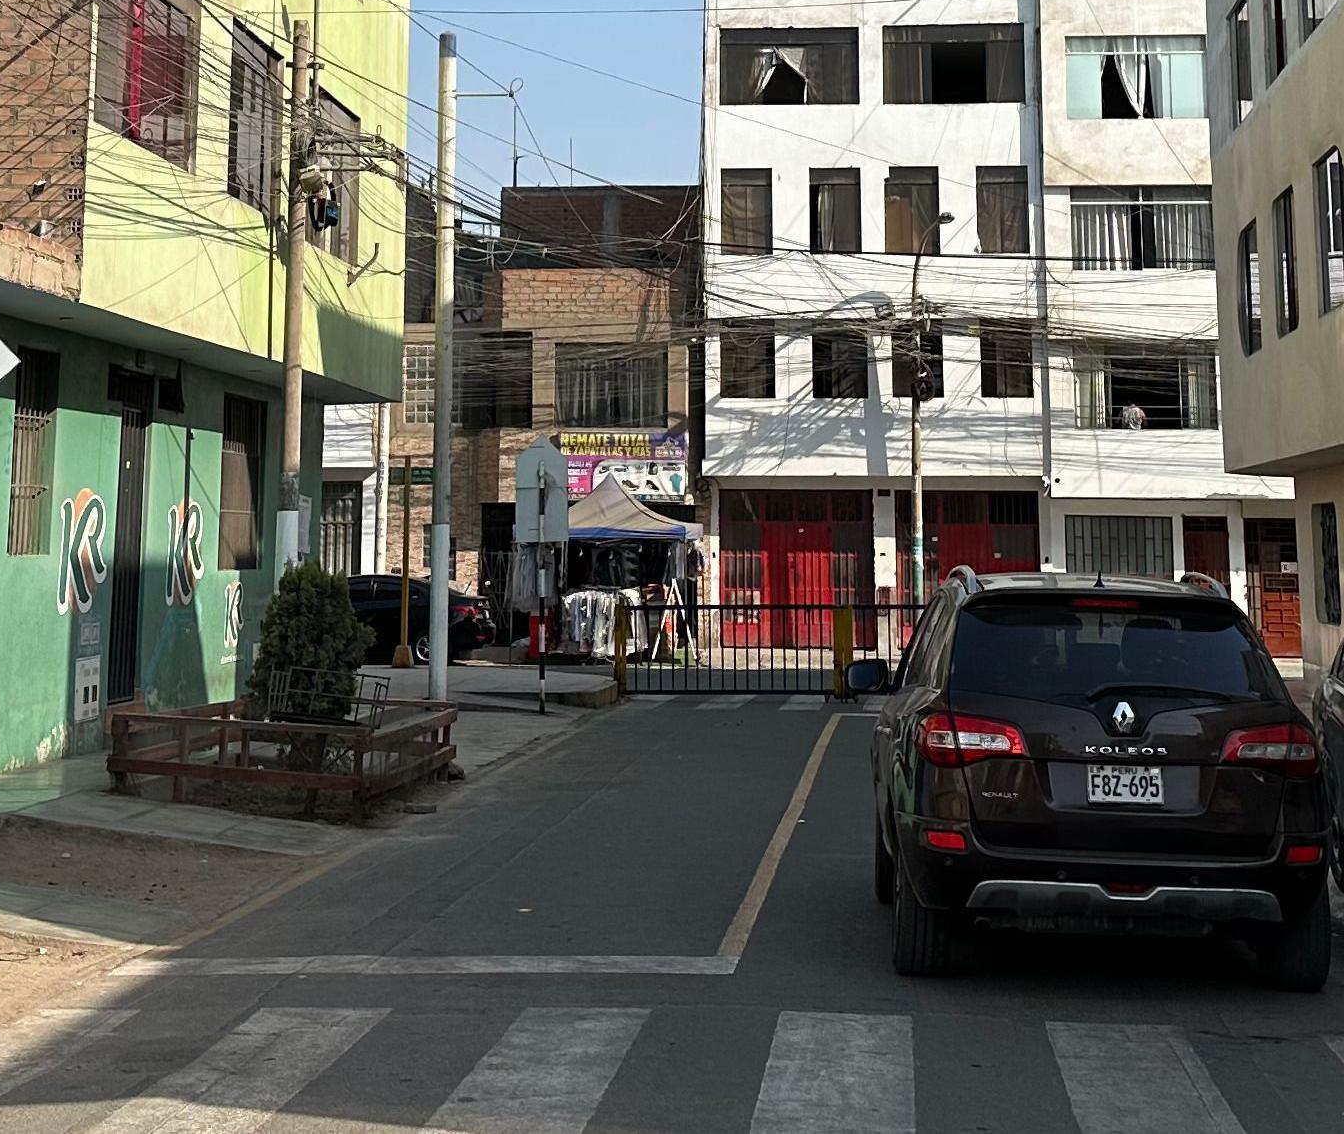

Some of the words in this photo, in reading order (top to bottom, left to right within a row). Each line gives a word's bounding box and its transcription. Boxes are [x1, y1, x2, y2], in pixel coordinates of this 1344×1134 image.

[560, 433, 612, 447] REMATE
[613, 433, 650, 447] TOTAL
[560, 446, 572, 456] DE
[573, 446, 623, 457] ZAPATILLAS
[1084, 745, 1168, 756] KOLEOS
[1090, 774, 1160, 798] F8Z-695
